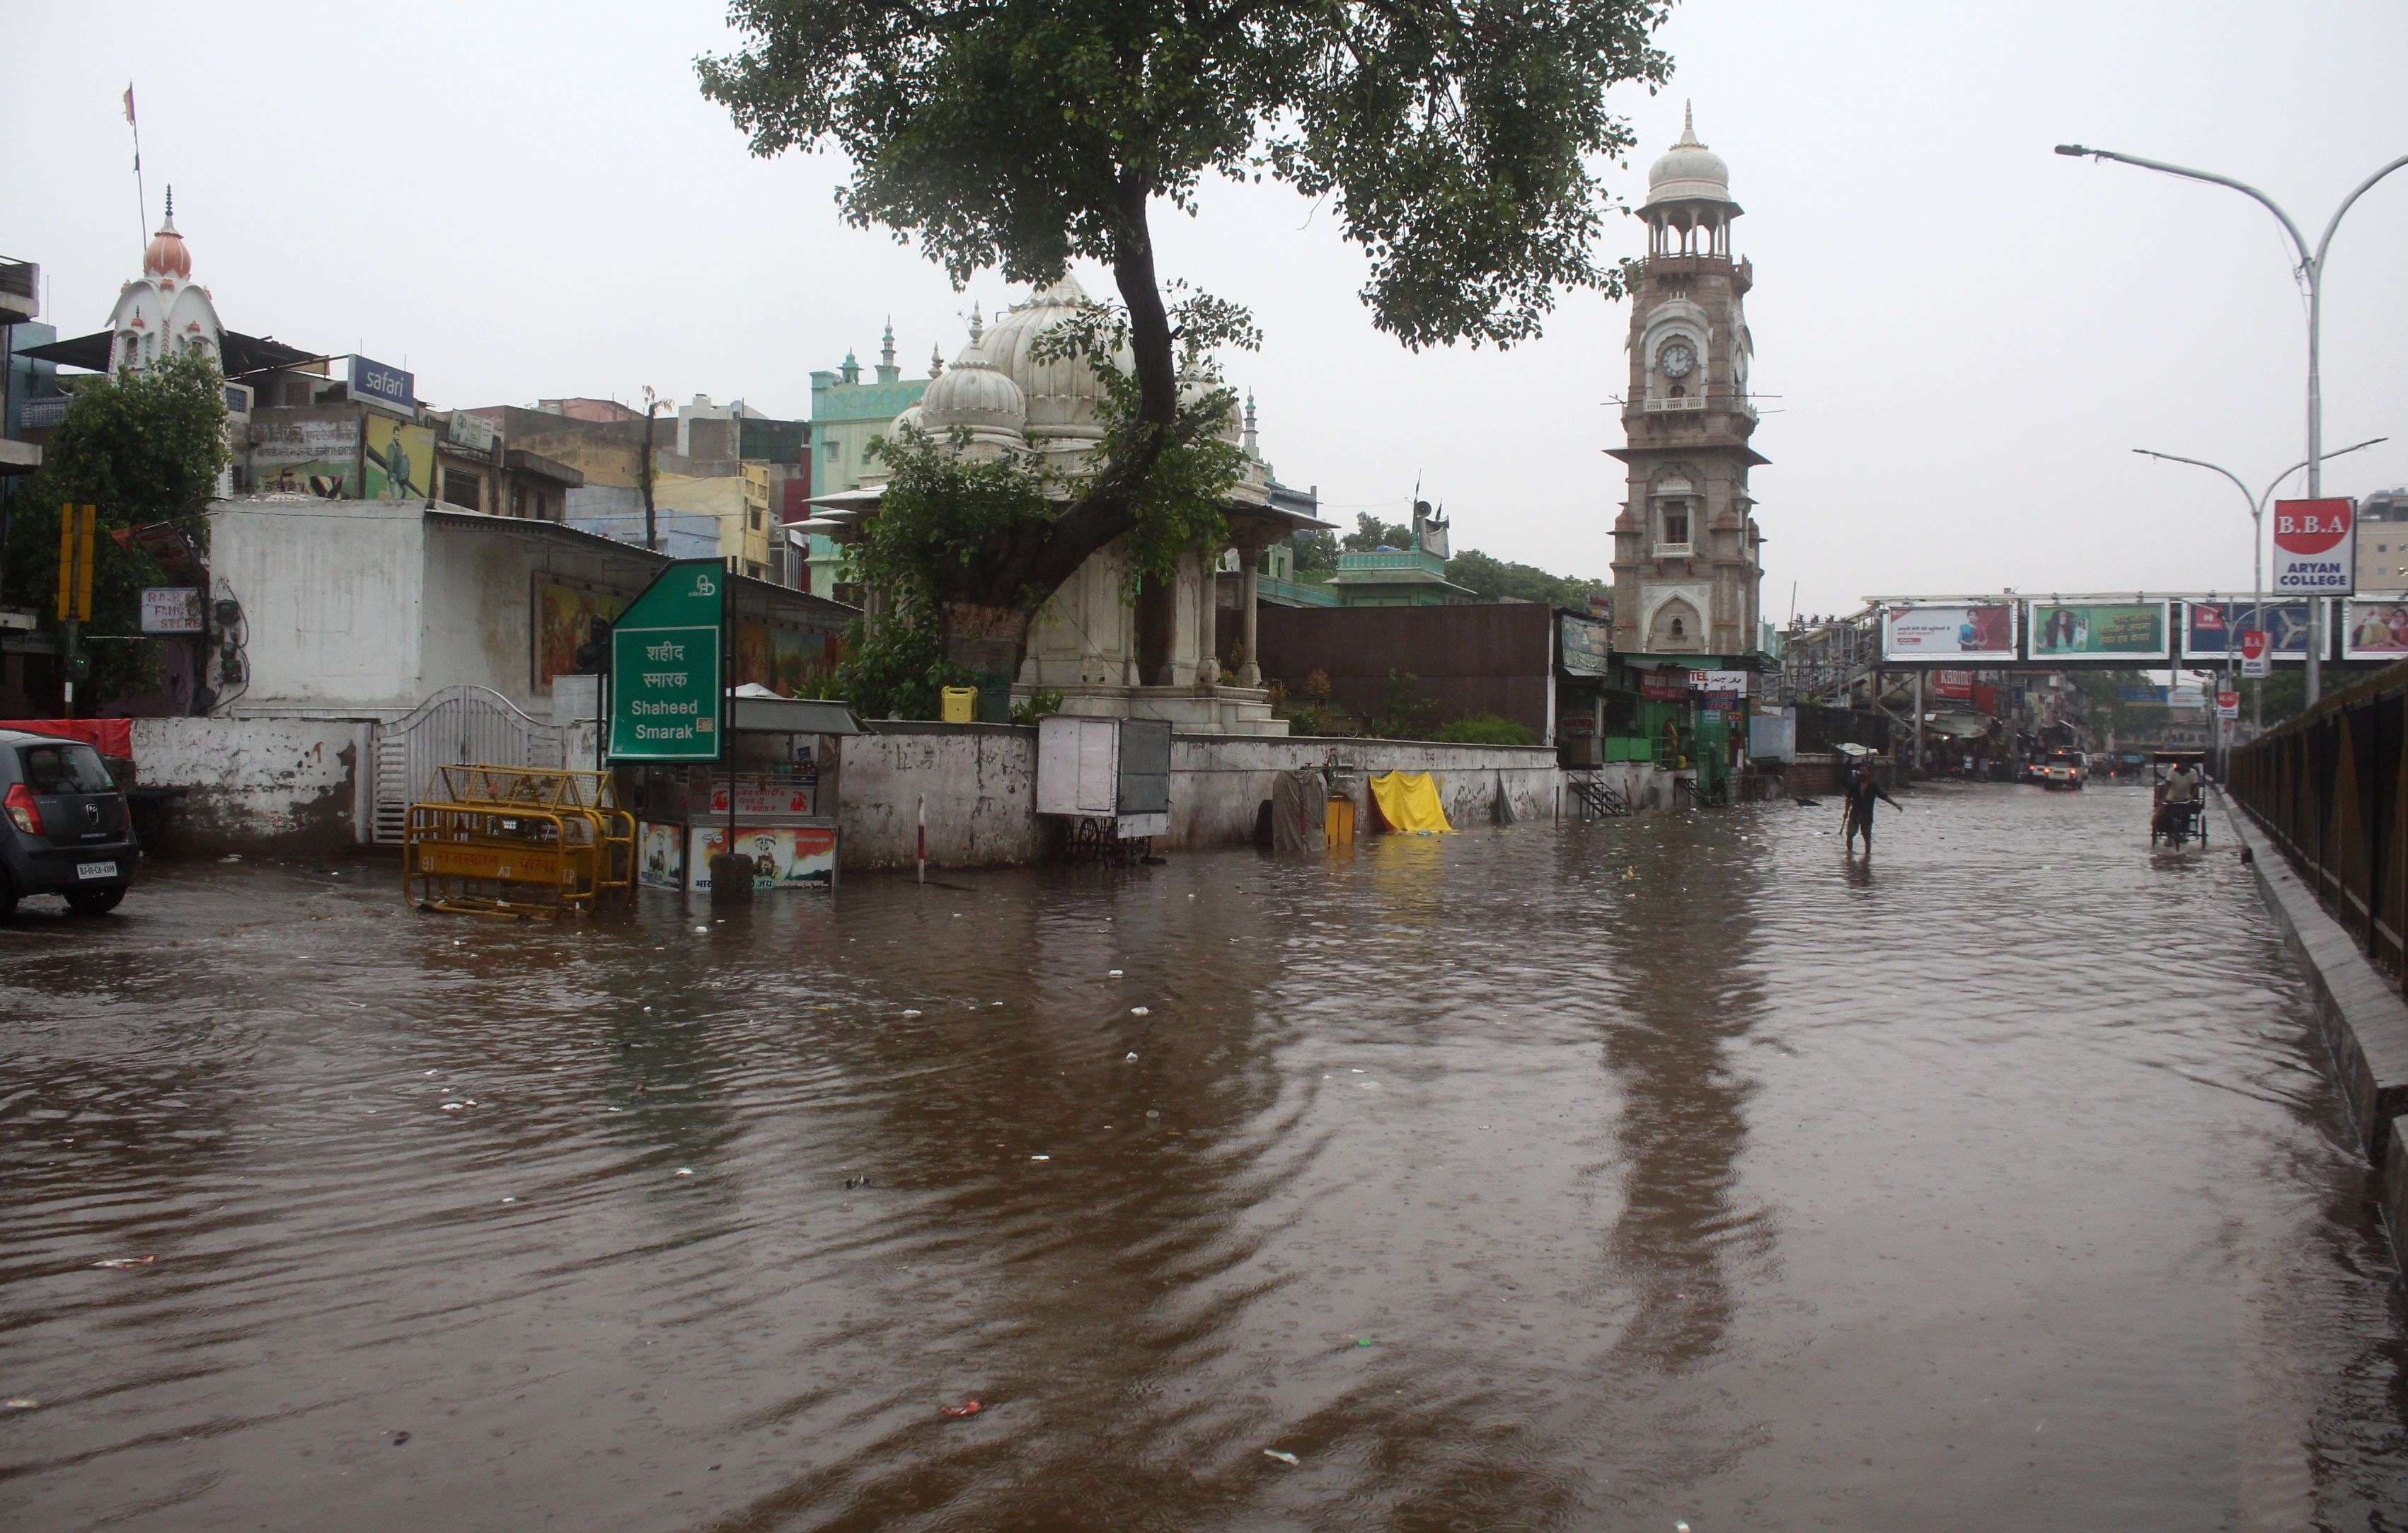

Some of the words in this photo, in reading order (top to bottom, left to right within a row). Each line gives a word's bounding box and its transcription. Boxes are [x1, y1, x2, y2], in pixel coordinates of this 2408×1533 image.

[367, 371, 404, 398] safari
[2278, 516, 2346, 533] B.B.A
[2288, 562, 2341, 573] ARYAN
[2280, 575, 2346, 586] COLLEGE
[159, 618, 201, 628] STORE
[645, 641, 686, 661] शहीद
[642, 672, 689, 688] स्मारक
[1690, 671, 1709, 681] TEL
[631, 700, 698, 715] Shaheed
[635, 724, 693, 739] Smarak
